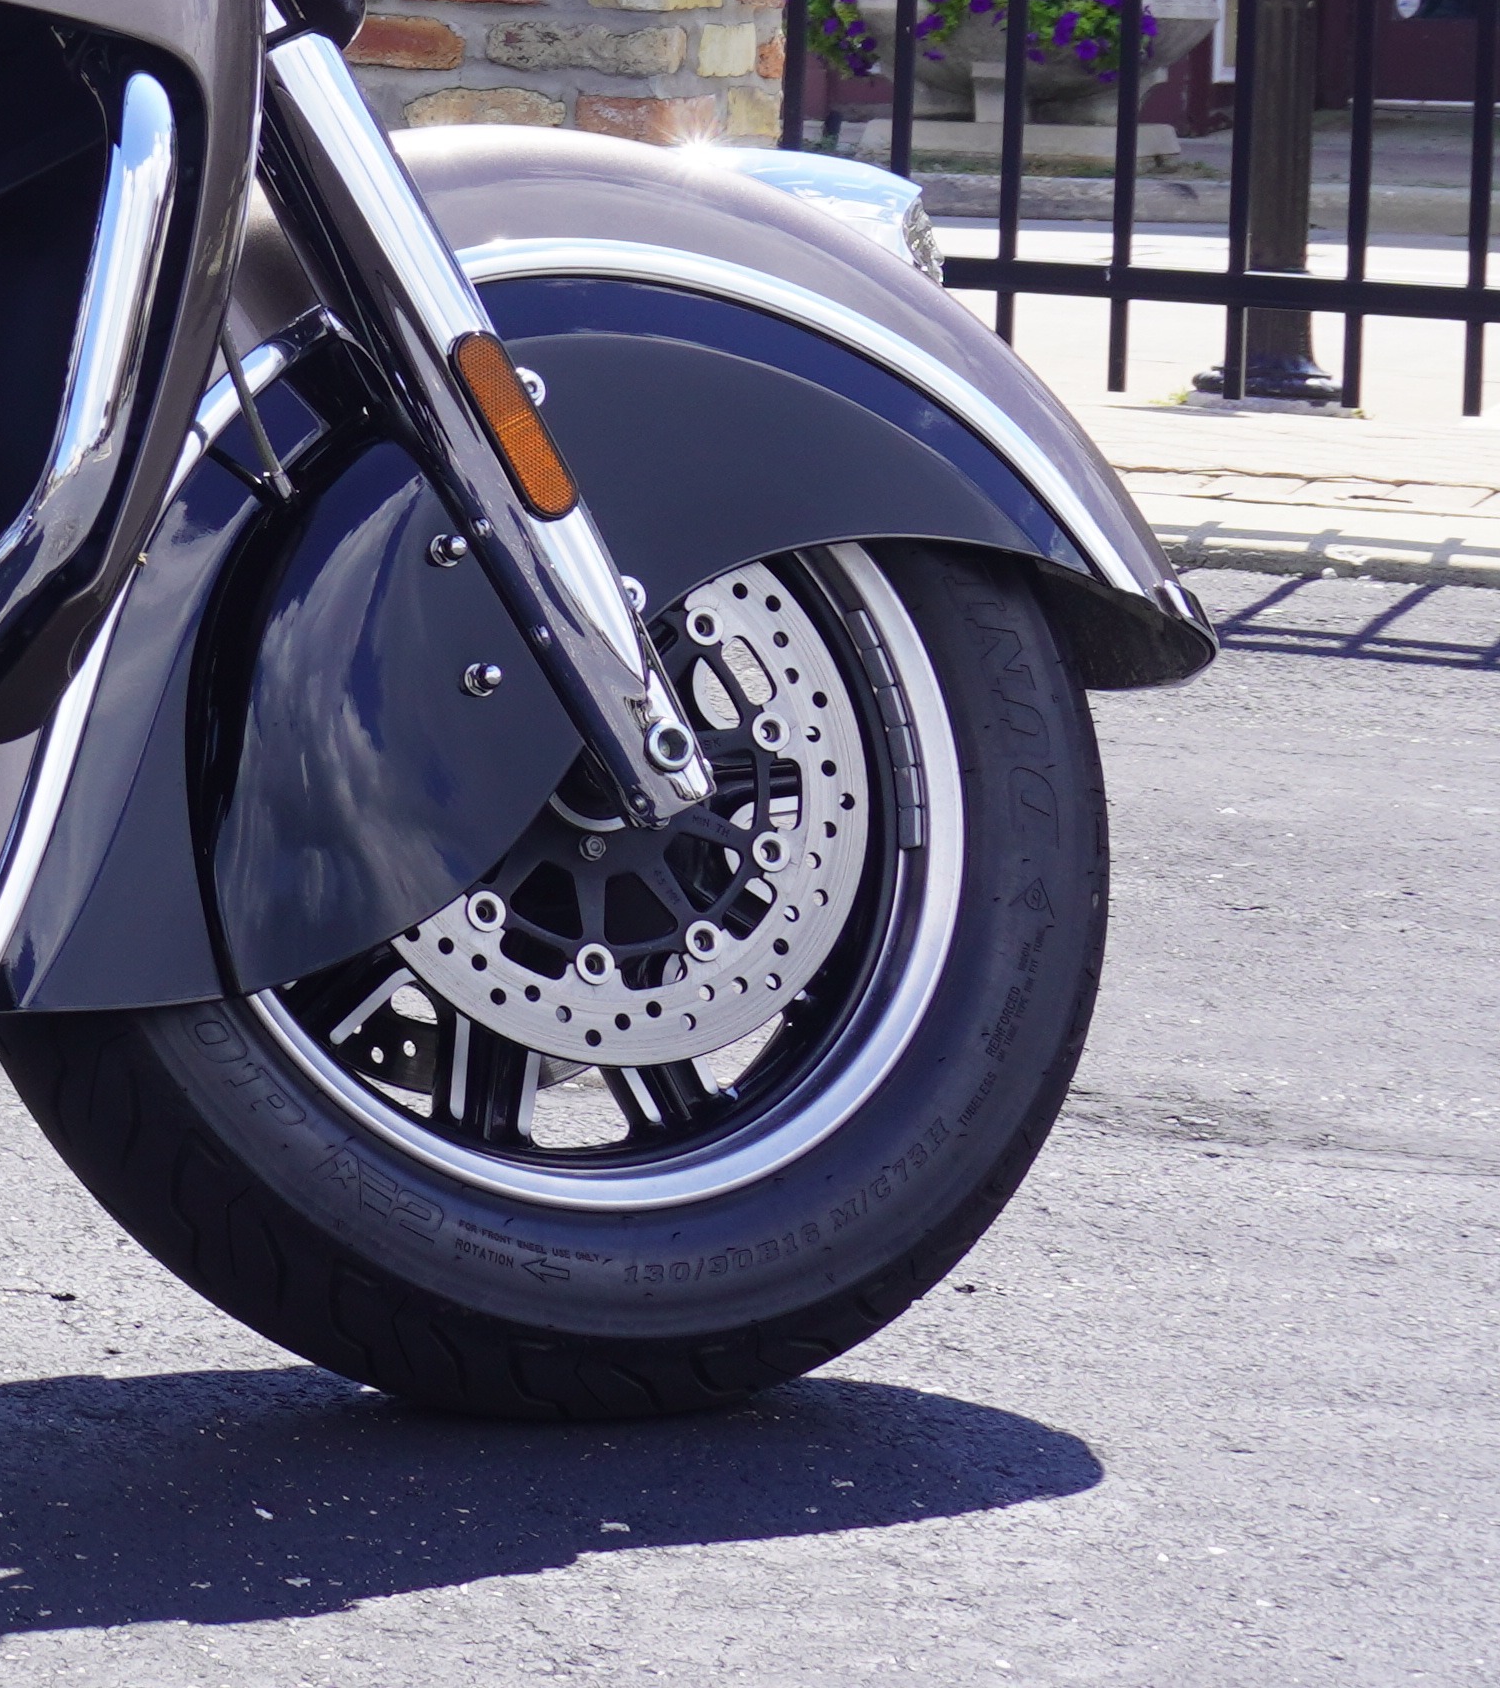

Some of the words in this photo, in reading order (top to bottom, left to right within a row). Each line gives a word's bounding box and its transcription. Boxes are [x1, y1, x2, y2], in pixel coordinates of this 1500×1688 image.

[957, 1070, 998, 1128] TUBELESS
[985, 986, 1022, 1058] REINFORCED
[455, 1237, 515, 1269] ROTATION
[481, 1228, 512, 1246] FRONT
